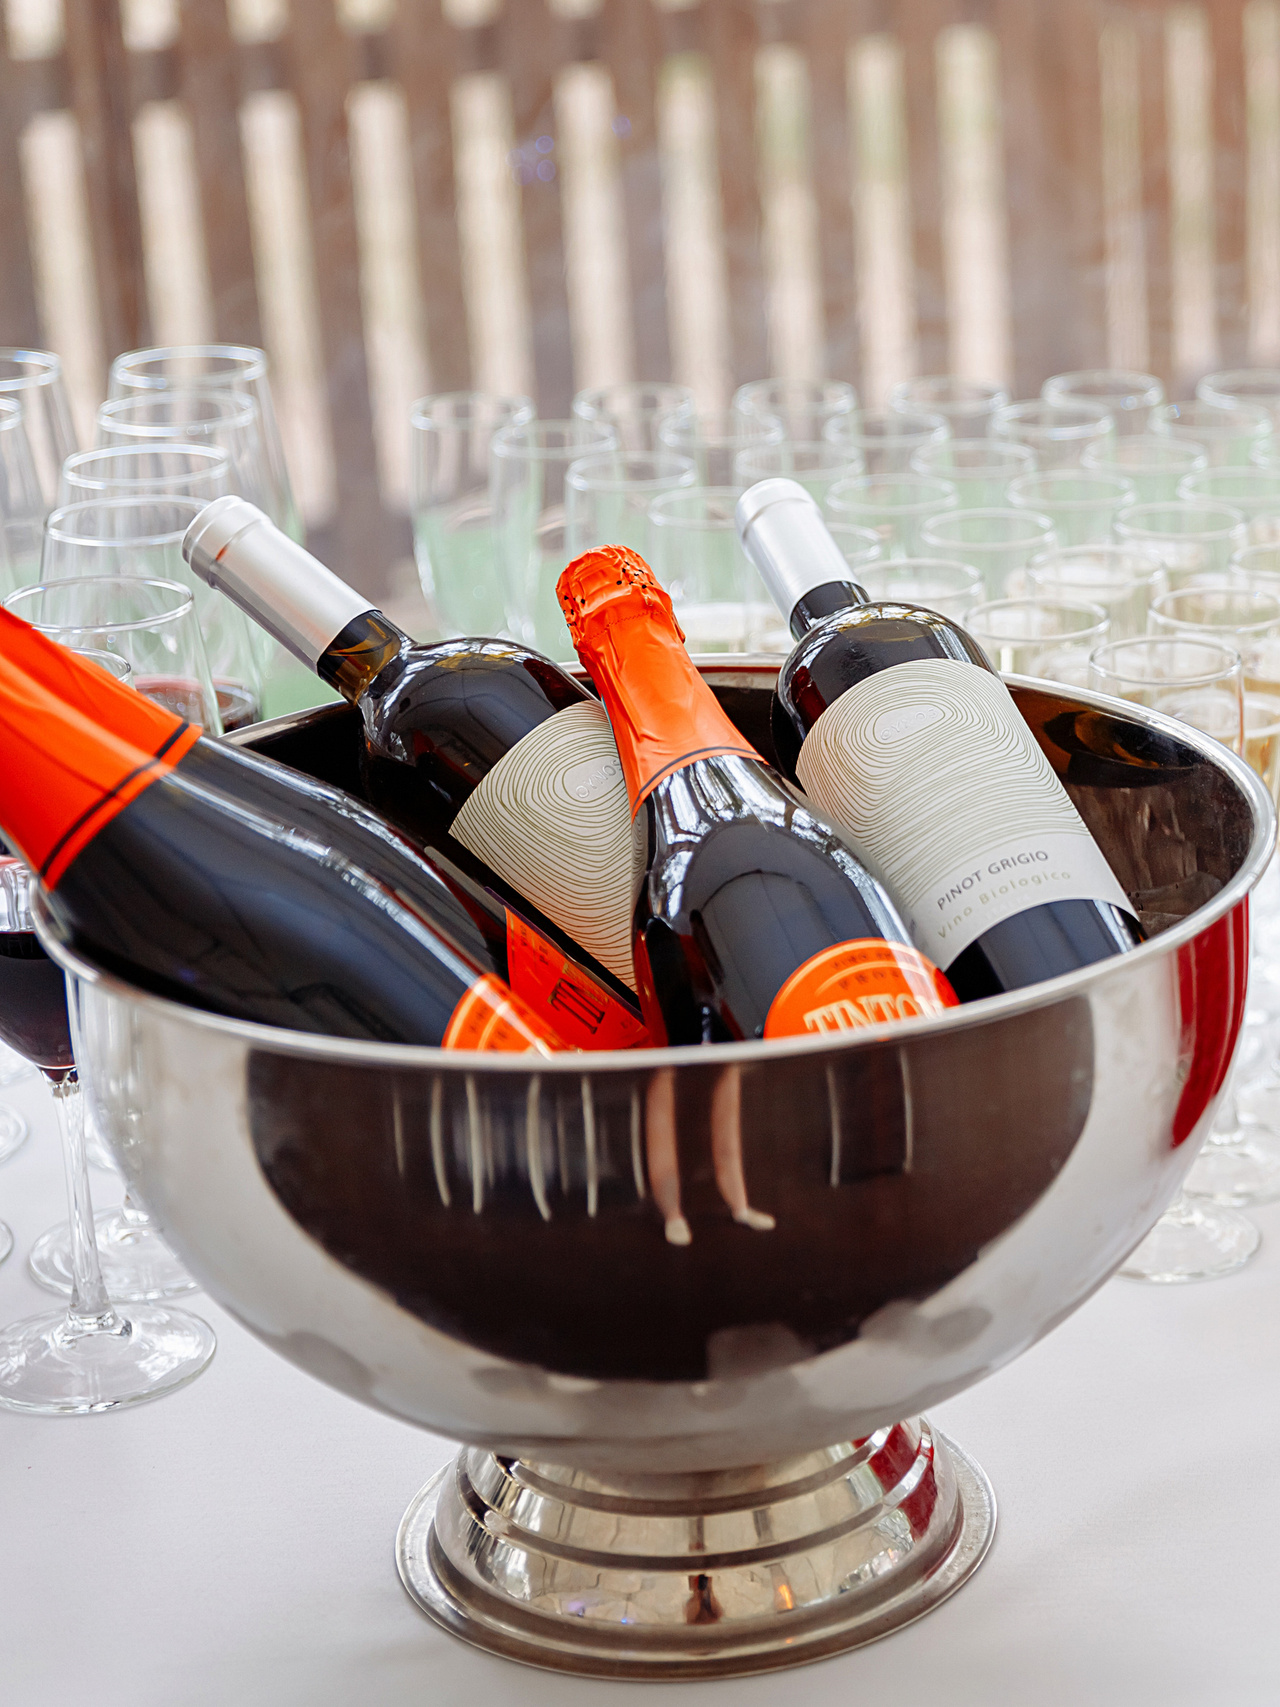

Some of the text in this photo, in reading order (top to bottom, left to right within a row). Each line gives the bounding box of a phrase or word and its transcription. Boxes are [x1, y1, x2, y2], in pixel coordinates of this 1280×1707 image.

[937, 870, 983, 911] PINOT
[988, 850, 1049, 875] GRIGIO
[938, 907, 973, 939] Vino
[978, 871, 1071, 905] Biologico
